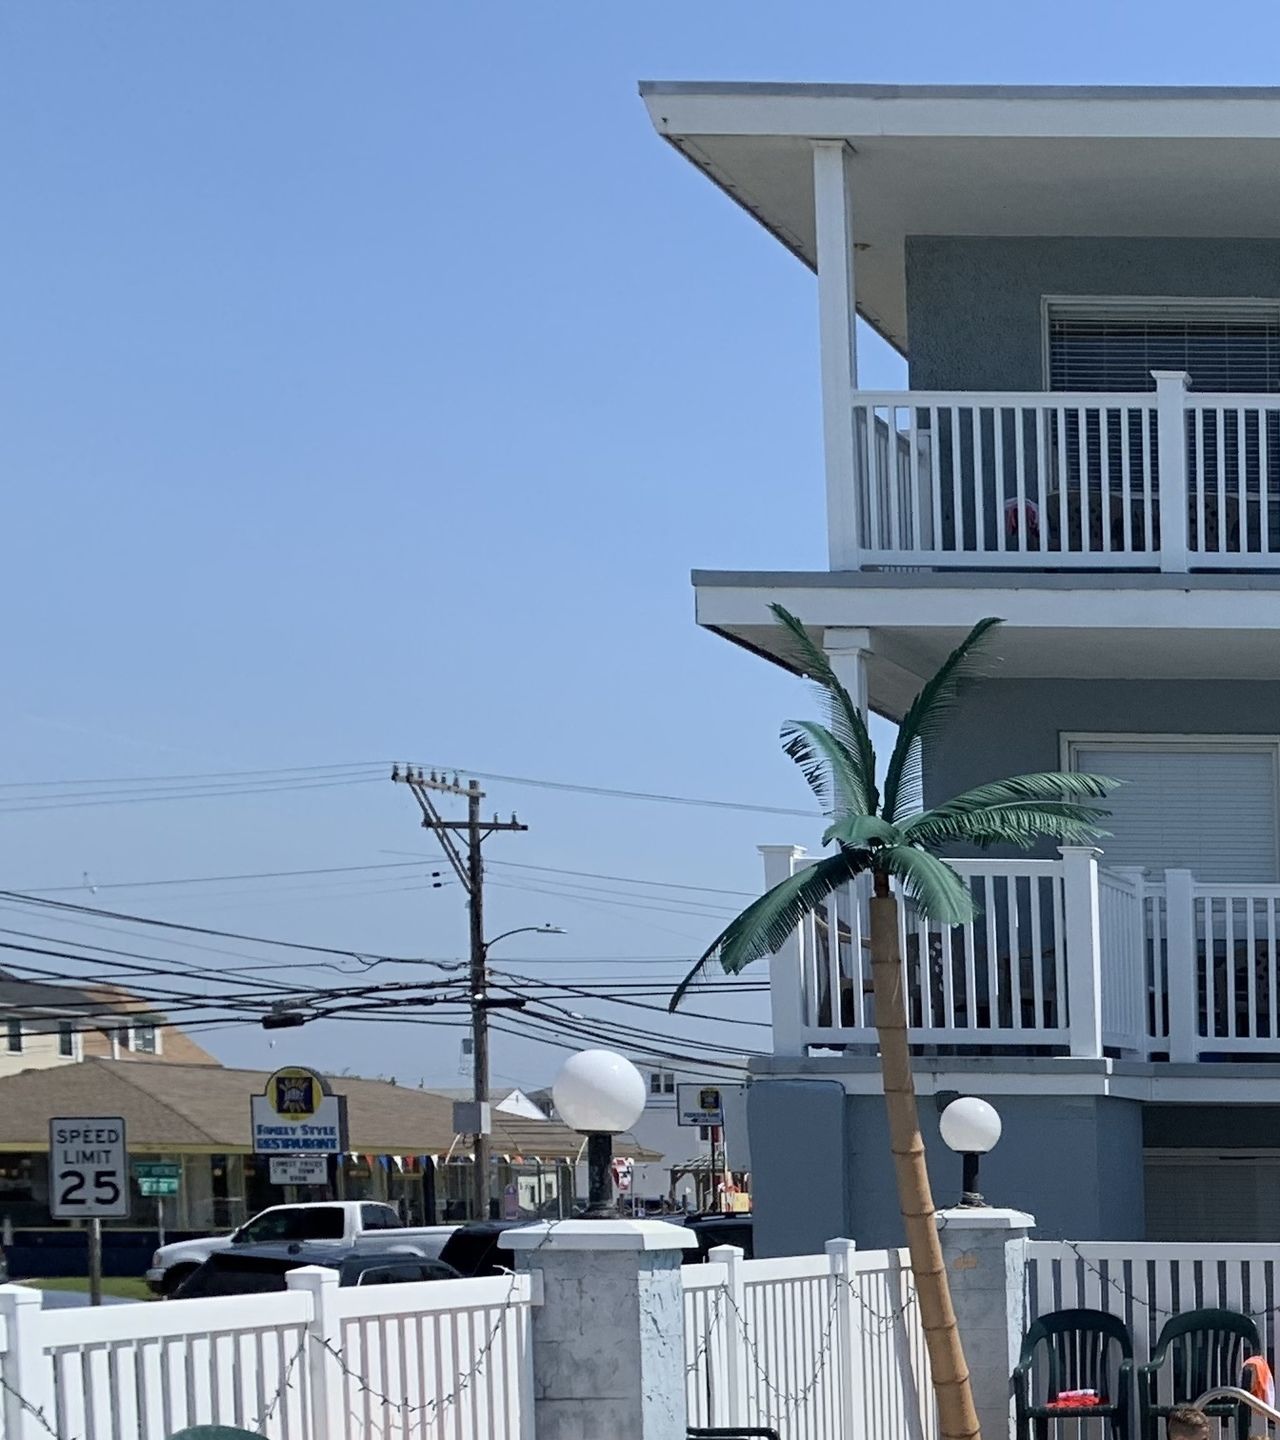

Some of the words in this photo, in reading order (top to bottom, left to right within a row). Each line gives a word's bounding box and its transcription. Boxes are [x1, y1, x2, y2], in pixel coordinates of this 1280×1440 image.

[56, 1129, 119, 1144] SPEED
[300, 1124, 337, 1136] STYLE
[256, 1138, 337, 1149] RESTAURANT
[64, 1150, 112, 1164] LIMIT
[59, 1170, 120, 1205] 25
